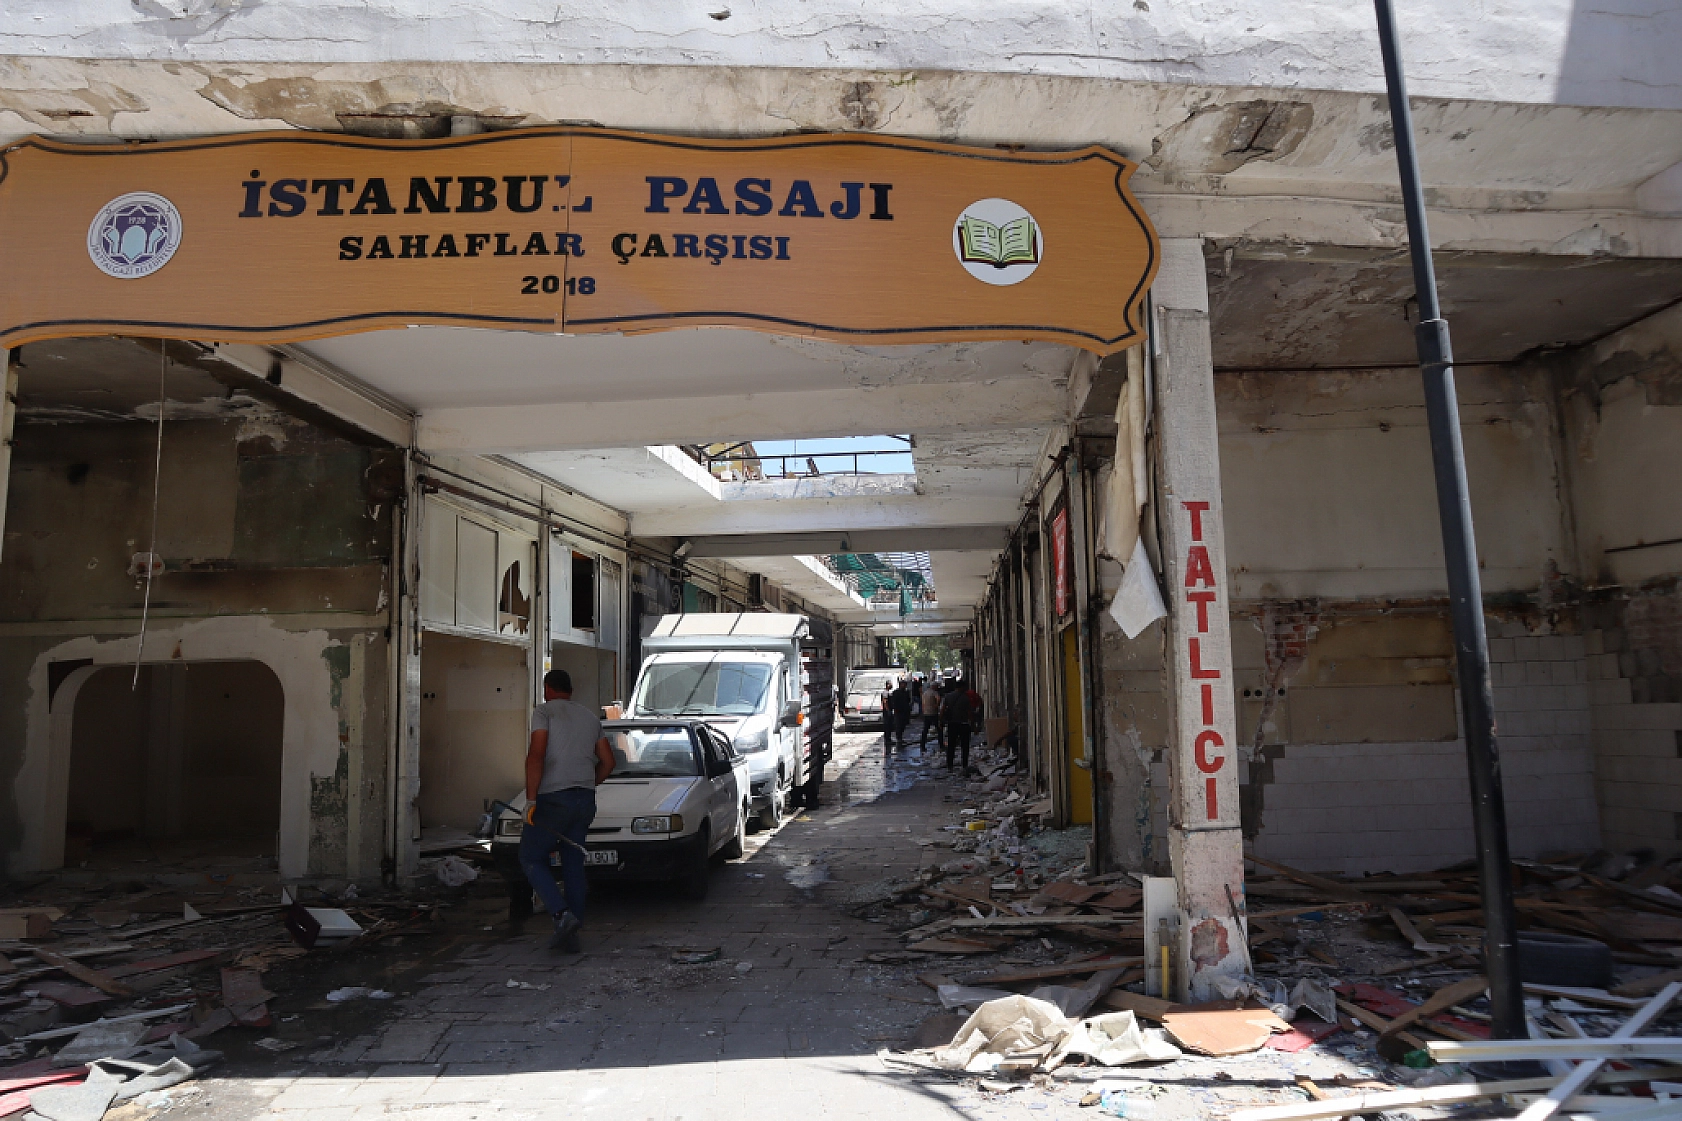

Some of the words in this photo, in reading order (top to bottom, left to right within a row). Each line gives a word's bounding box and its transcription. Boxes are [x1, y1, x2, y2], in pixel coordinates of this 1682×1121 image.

[645, 177, 893, 221] PASAJI
[340, 232, 585, 262] SAHAFLAR
[612, 234, 790, 265] ÇARŞISI
[521, 272, 595, 298] 2018
[1180, 501, 1226, 820] TATLICI
